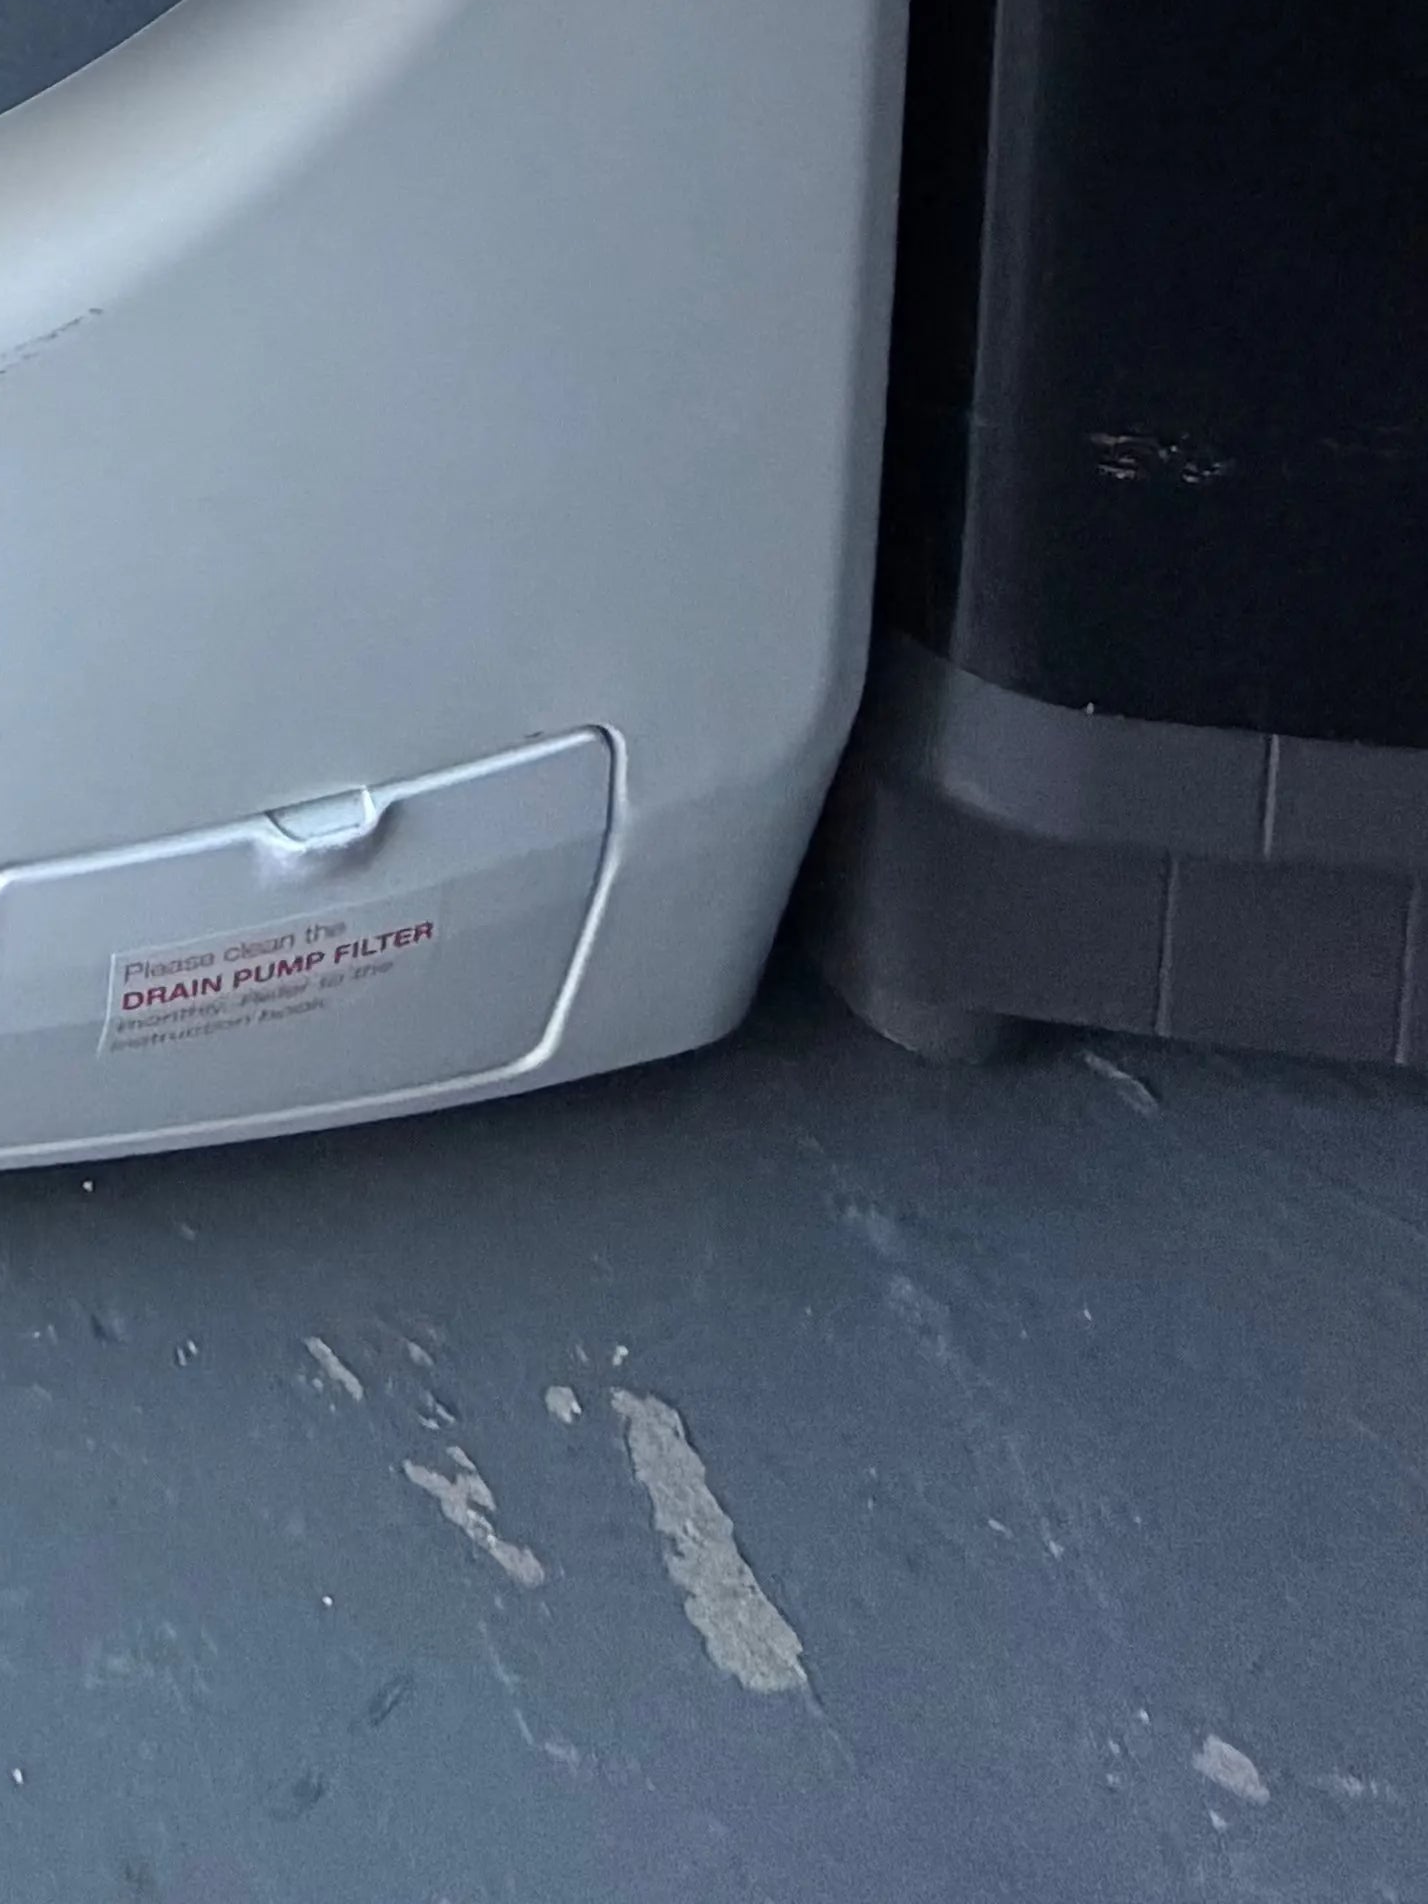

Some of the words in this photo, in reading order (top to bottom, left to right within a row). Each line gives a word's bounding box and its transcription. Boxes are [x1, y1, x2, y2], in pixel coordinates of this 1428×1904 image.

[121, 973, 223, 1012] DRAIN
[232, 950, 326, 989] PUMP
[333, 919, 435, 965] FILTER
[123, 952, 216, 983] Please
[223, 931, 296, 964] clean
[304, 918, 348, 945] the
